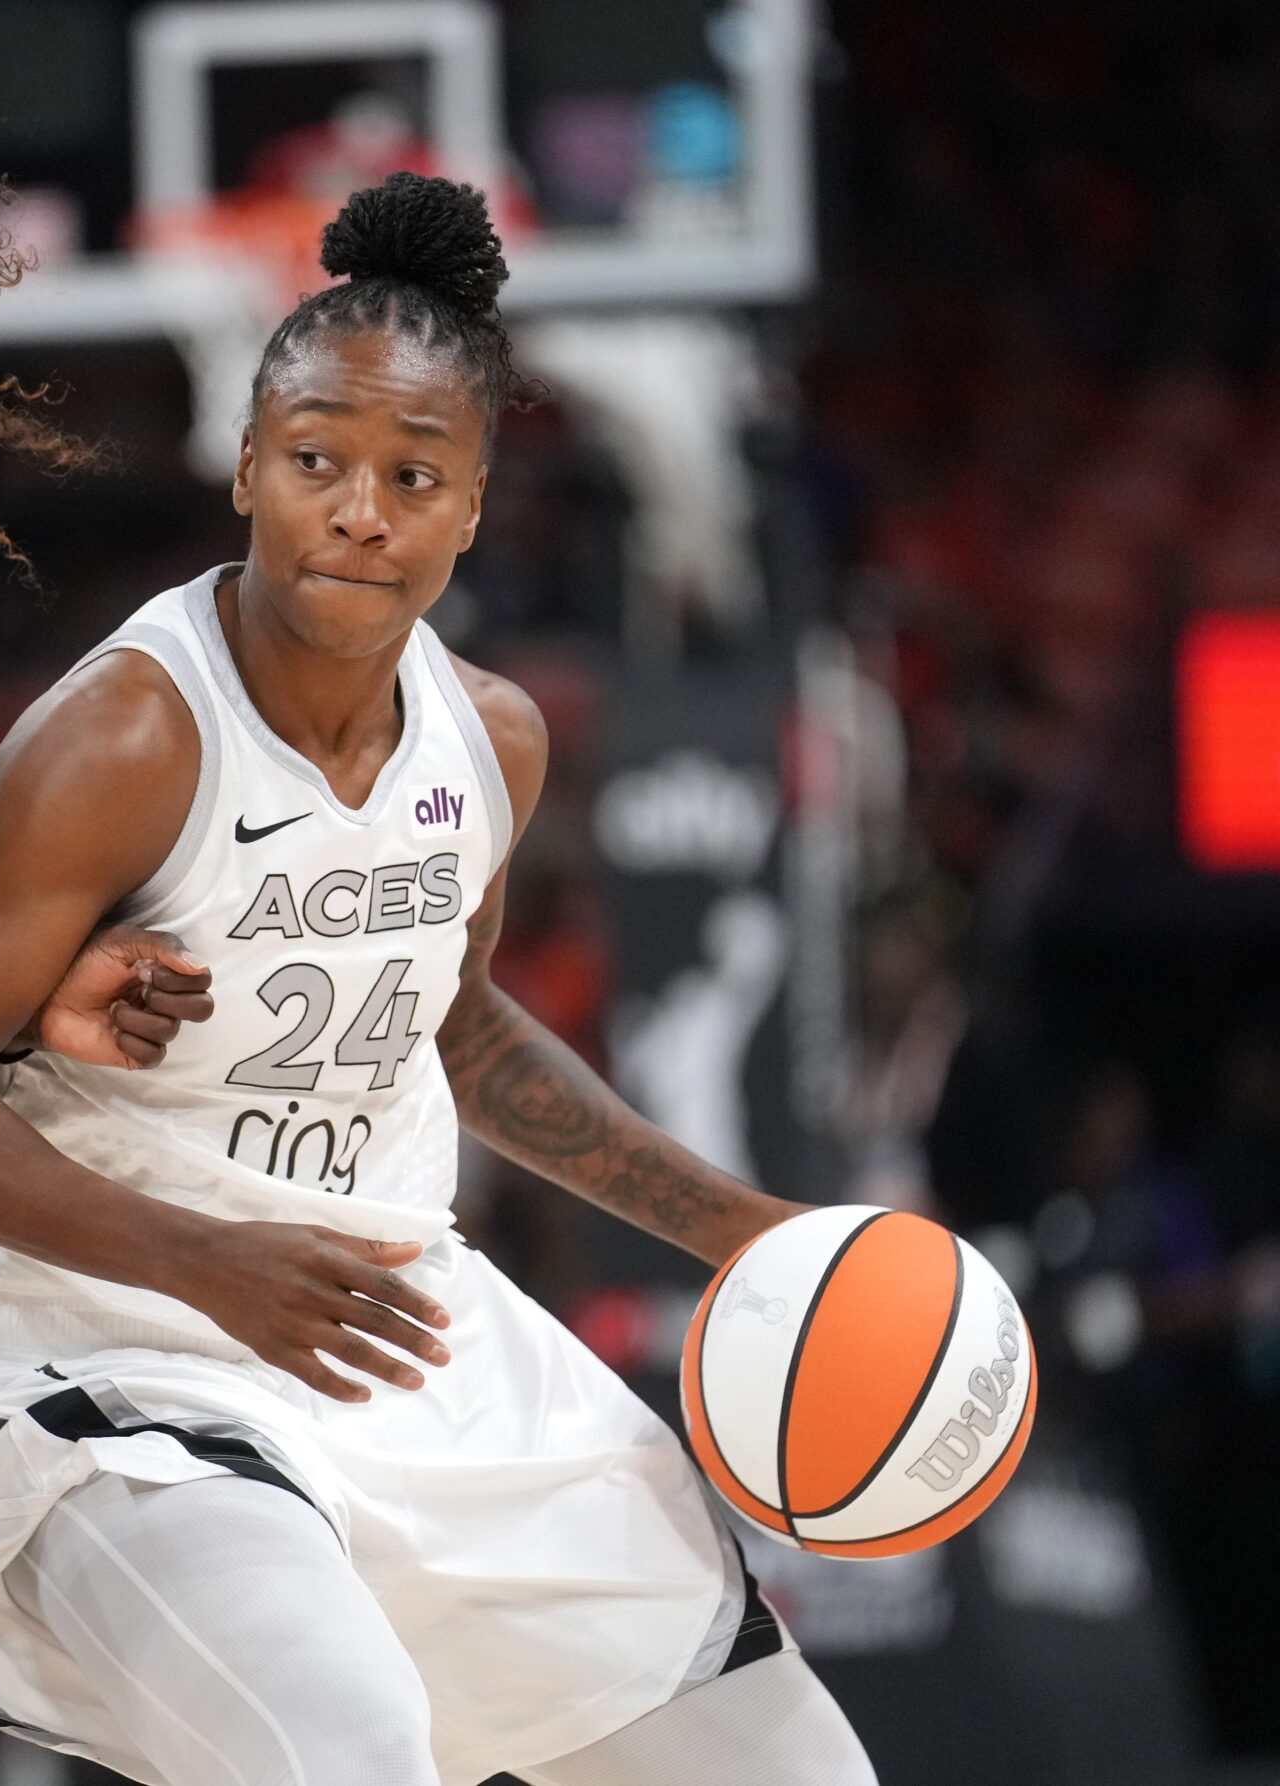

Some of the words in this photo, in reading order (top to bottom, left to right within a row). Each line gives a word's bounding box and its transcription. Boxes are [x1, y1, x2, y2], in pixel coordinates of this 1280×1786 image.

[414, 787, 465, 830] ally
[227, 853, 462, 939] ACES
[225, 959, 420, 1091] 24
[227, 1101, 372, 1196] ring
[905, 1286, 1020, 1492] Wilson
